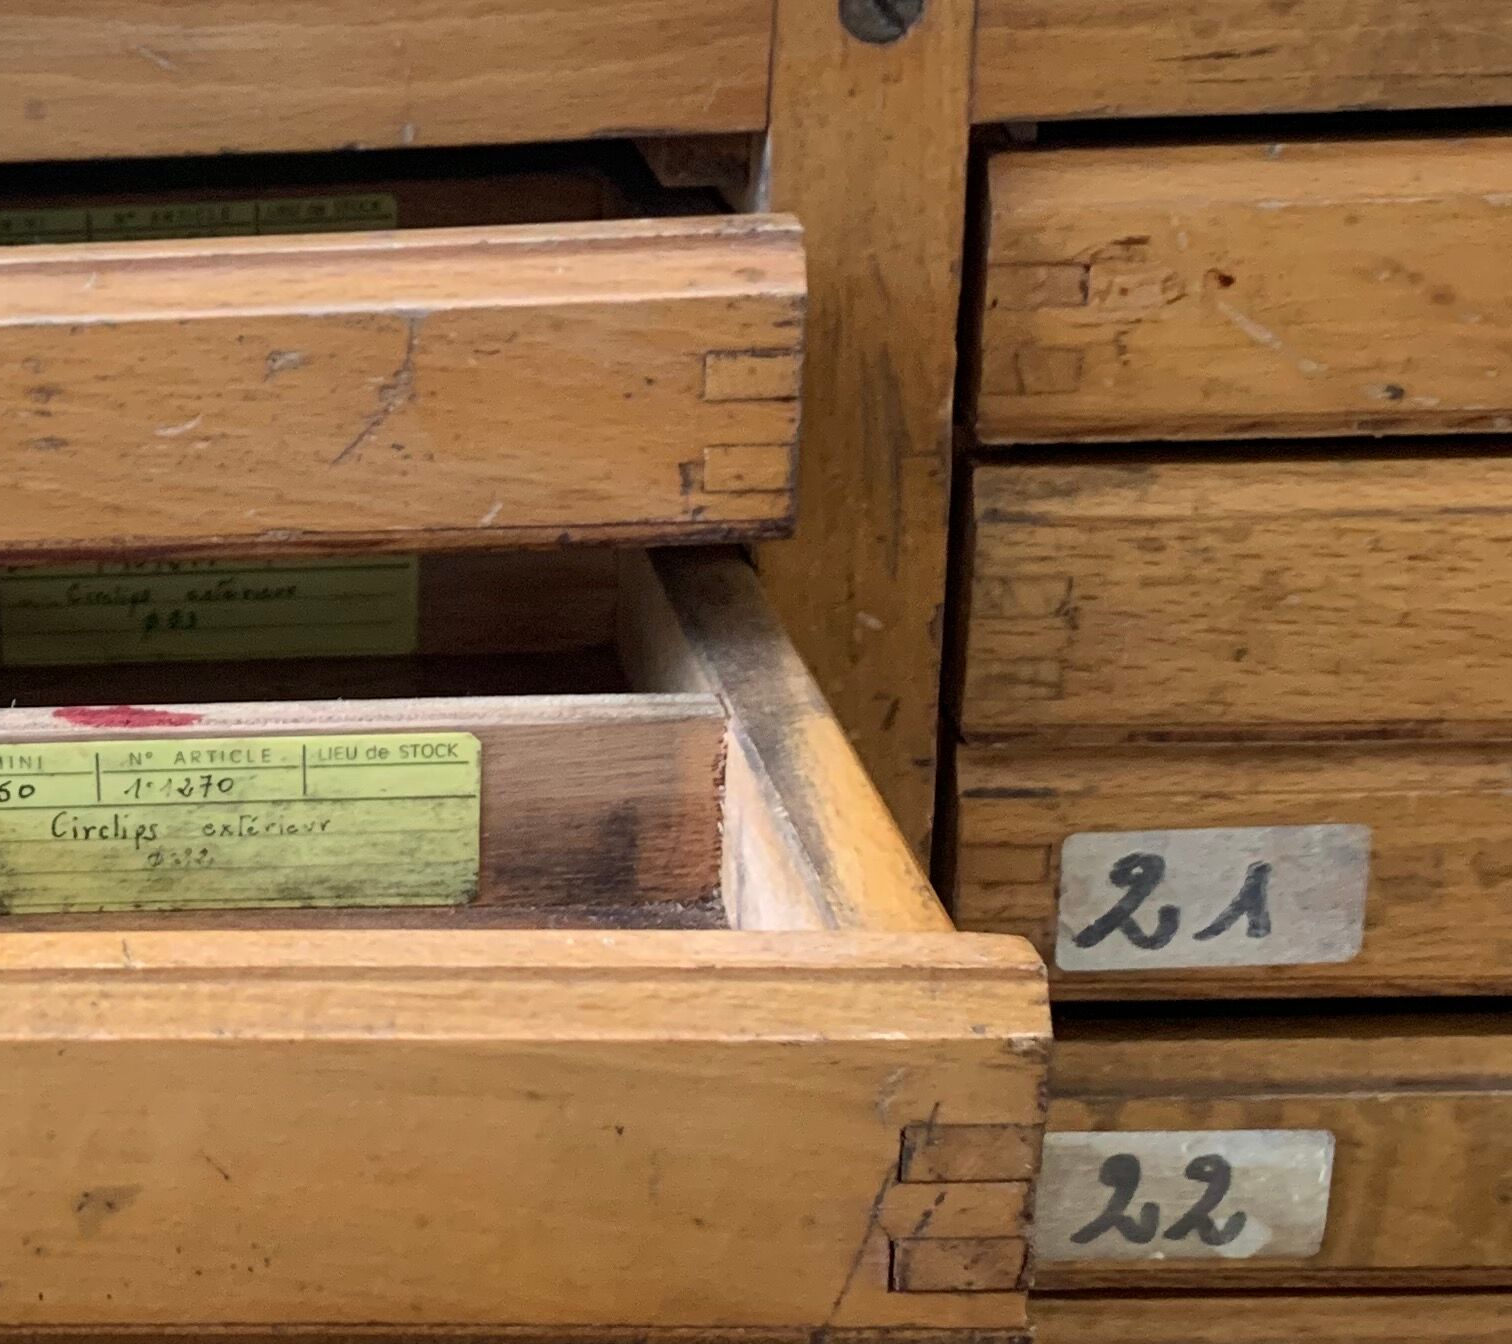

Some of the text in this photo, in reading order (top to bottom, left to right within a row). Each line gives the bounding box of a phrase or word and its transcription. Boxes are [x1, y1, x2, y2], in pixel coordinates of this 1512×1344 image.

[173, 748, 272, 766] ARTICLE
[317, 746, 358, 762] LIEU
[365, 745, 390, 760] de
[398, 742, 460, 759] STOCK
[50, 810, 159, 850] Circlips
[1072, 851, 1272, 950] 21
[1069, 1153, 1248, 1246] 22
